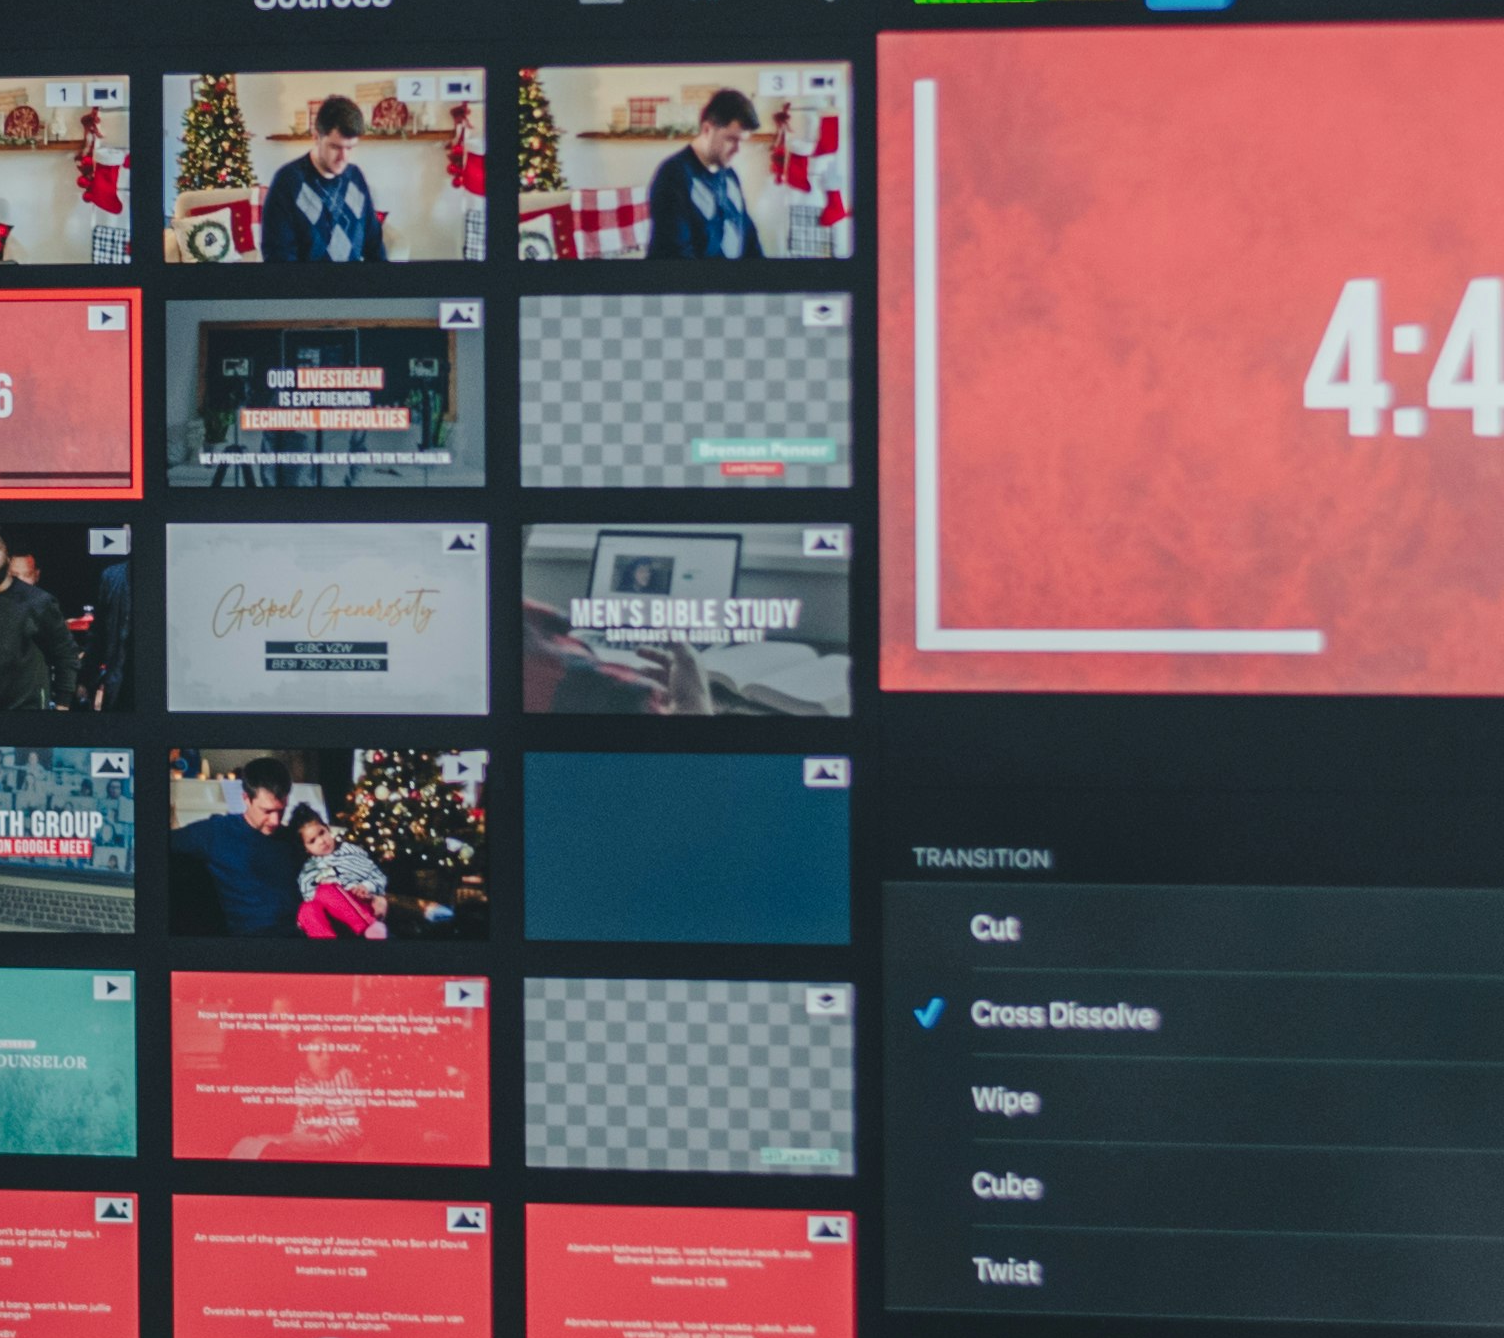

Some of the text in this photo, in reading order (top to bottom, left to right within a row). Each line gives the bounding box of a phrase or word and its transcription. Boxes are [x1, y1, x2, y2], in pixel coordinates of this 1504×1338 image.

[412, 81, 422, 97] 2
[772, 75, 783, 91] 3
[59, 87, 67, 102] 1
[267, 369, 383, 388] OUR LIVESTREAM
[278, 391, 371, 408] IS EXPERIENCING
[243, 409, 408, 429] TECHNICAL DIFFICULTIES
[212, 583, 440, 638] Gospel Generosity
[570, 598, 802, 629] MEN'S BIBLE STUDY
[294, 644, 354, 653] GIBC VZW
[30, 810, 103, 838] GROUP
[14, 839, 57, 854] GOOGLE
[59, 839, 90, 855] MEET
[912, 847, 1053, 869] TRANSITION
[970, 914, 1021, 941] Cut
[970, 999, 1160, 1030] Cross Dissolve
[972, 1085, 1041, 1117] Wipe
[972, 1171, 1044, 1200] Cube
[972, 1257, 1043, 1286] Twist
